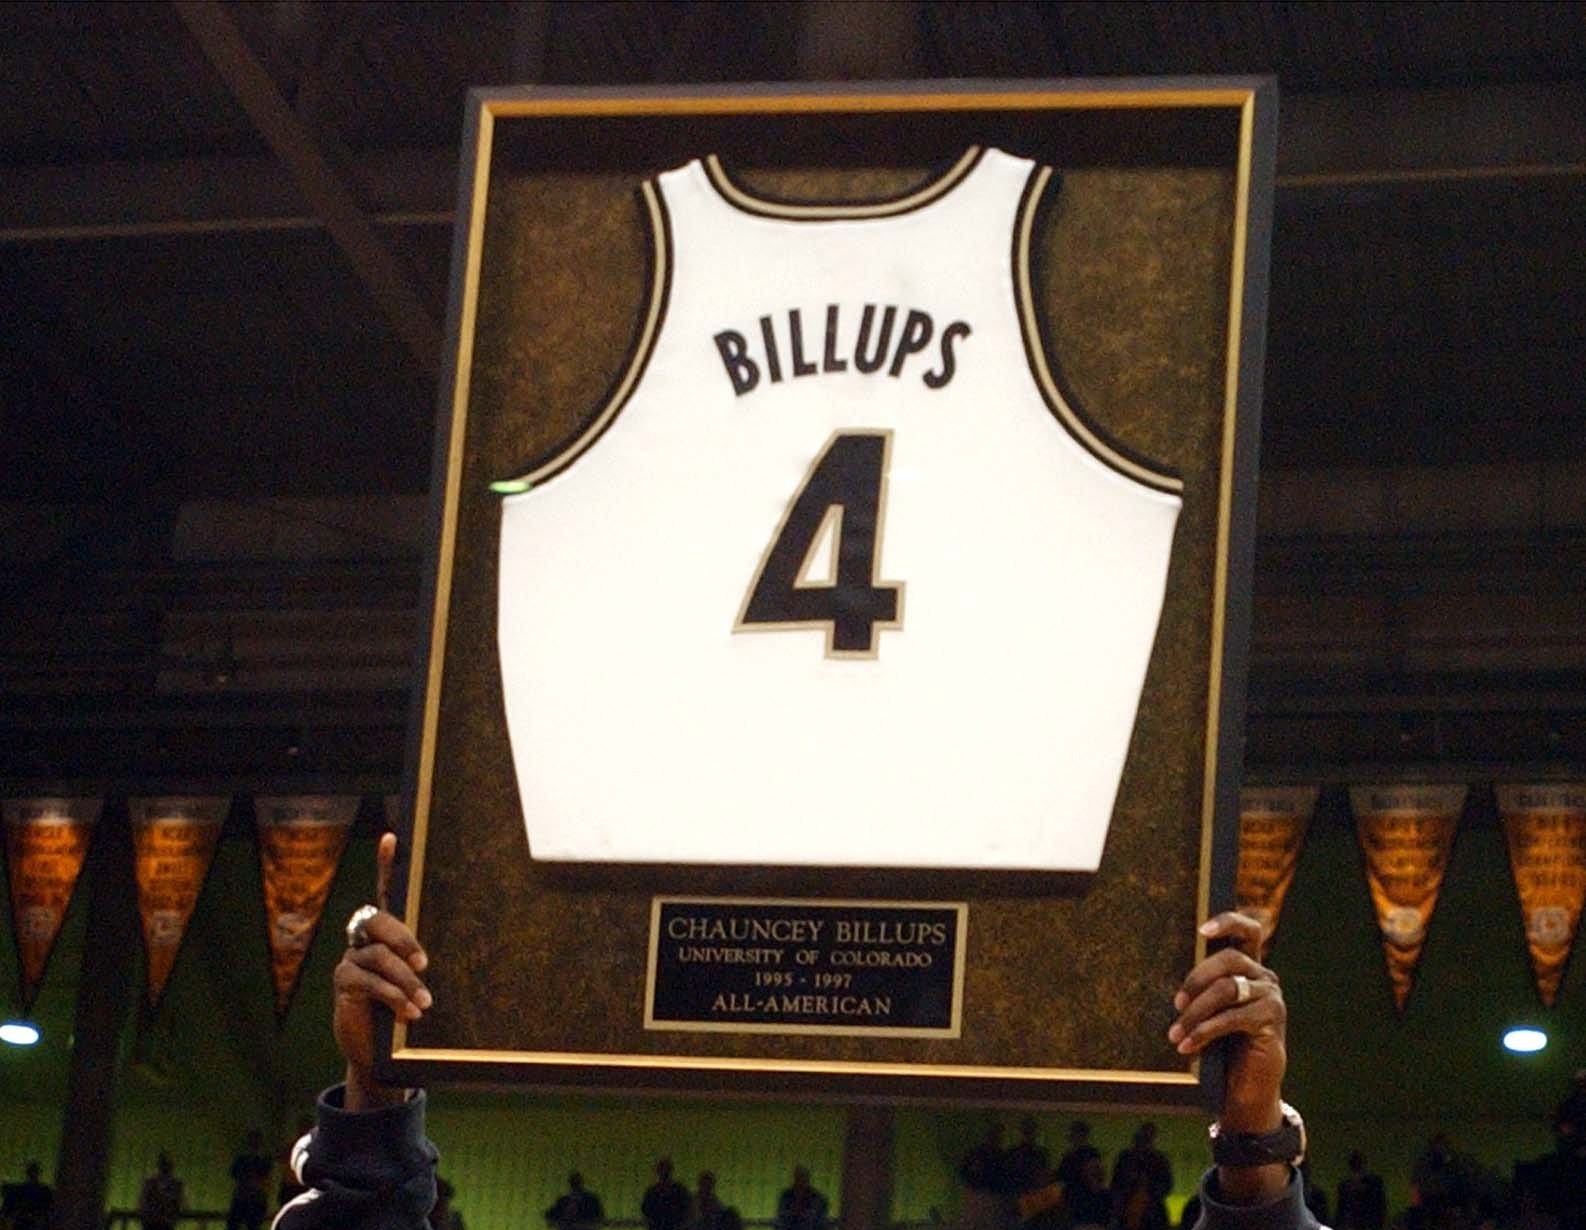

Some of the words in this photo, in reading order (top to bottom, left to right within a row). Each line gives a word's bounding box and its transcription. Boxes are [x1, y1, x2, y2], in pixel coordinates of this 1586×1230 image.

[713, 303, 972, 397] BILLUPS
[731, 427, 906, 660] 4
[668, 917, 824, 942] CHAUNCEY
[836, 920, 947, 945] BILLUPS
[678, 946, 784, 964] UNIVERSITY
[795, 950, 819, 966] OF
[829, 951, 933, 968] COLORADO
[754, 971, 794, 987] 1995
[814, 972, 853, 989] 1997
[711, 993, 892, 1015] ALL-AMERICAN
